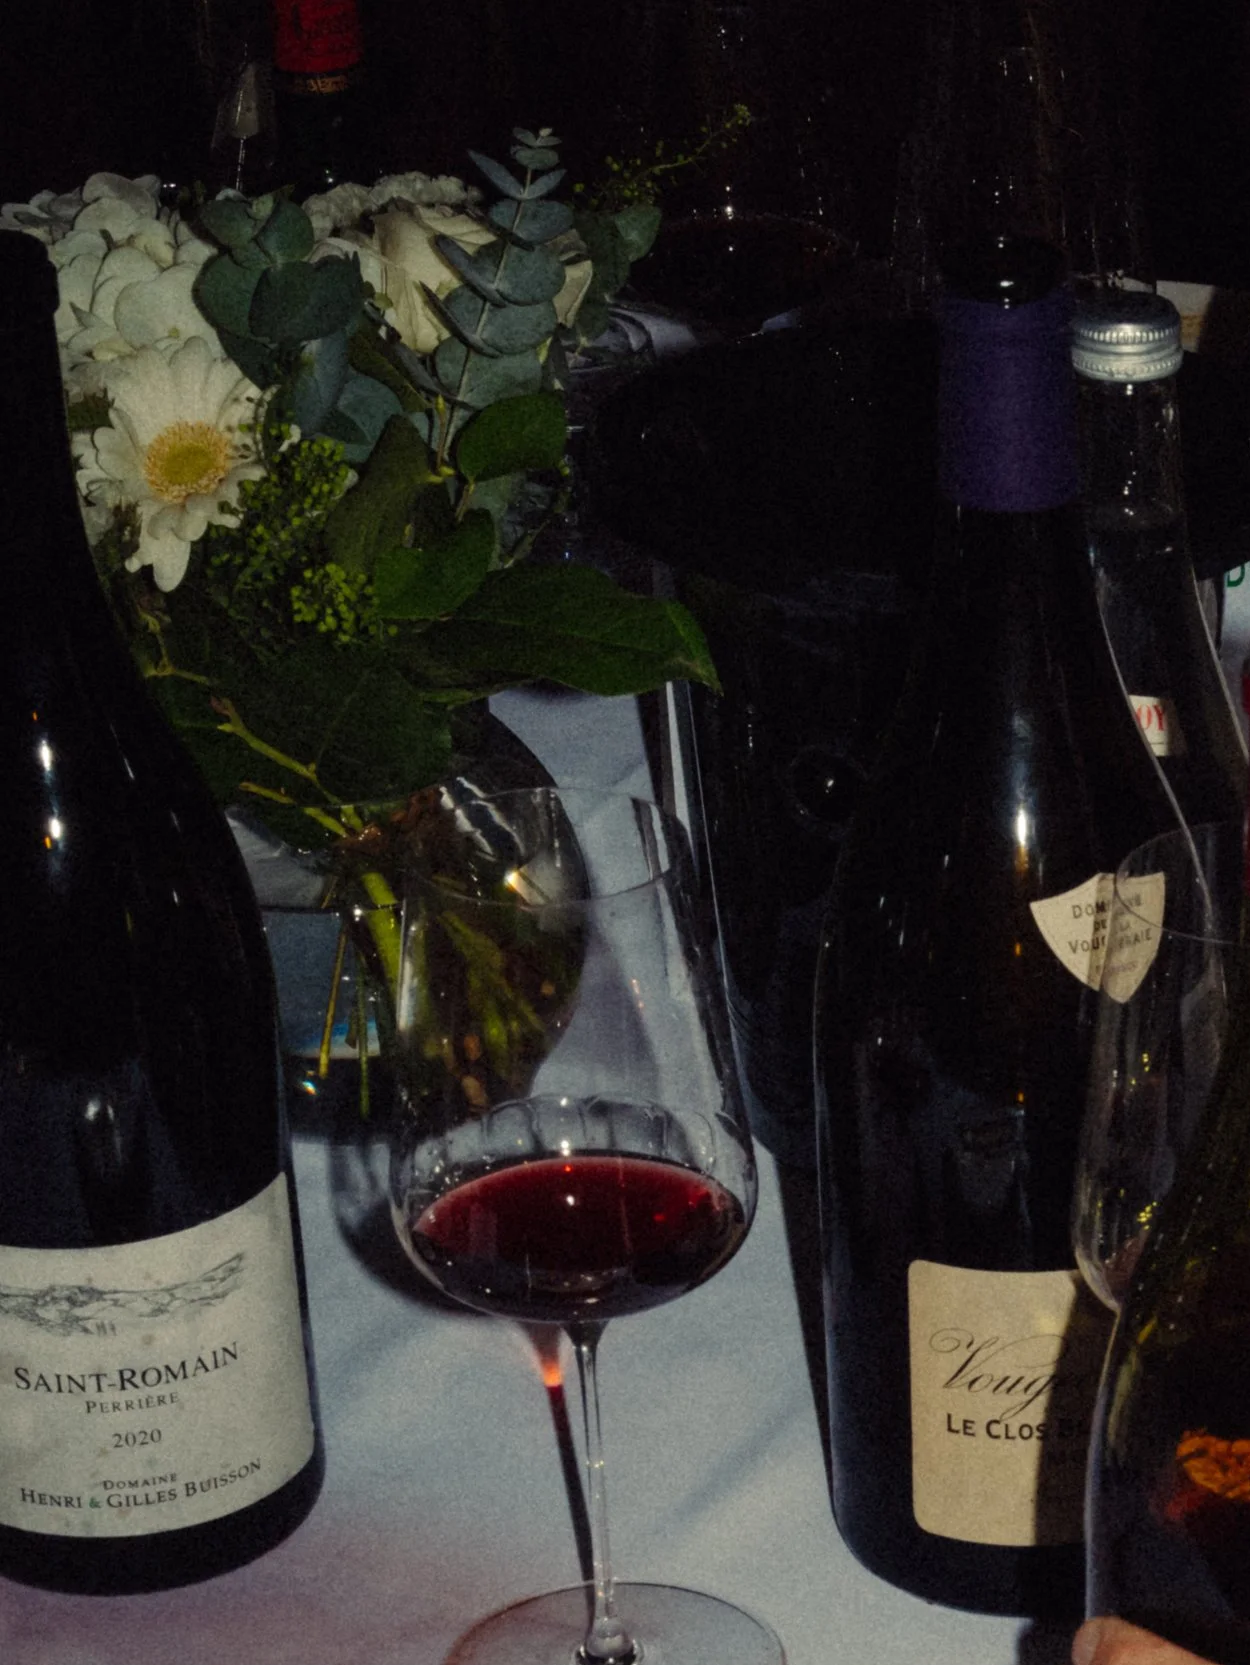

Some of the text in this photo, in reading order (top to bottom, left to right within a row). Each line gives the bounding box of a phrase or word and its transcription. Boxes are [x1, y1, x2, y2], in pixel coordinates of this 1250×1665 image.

[13, 1340, 240, 1394] SAINT-ROMAIN
[84, 1390, 181, 1415] PERRIÈRE
[111, 1427, 163, 1450] 2020
[946, 1412, 977, 1437] LE
[984, 1417, 1047, 1442] CLOS
[19, 1487, 84, 1510] HENRI
[106, 1485, 179, 1510] GILLES
[184, 1458, 262, 1499] BUISSON
[102, 1472, 179, 1491] DOMAINE
